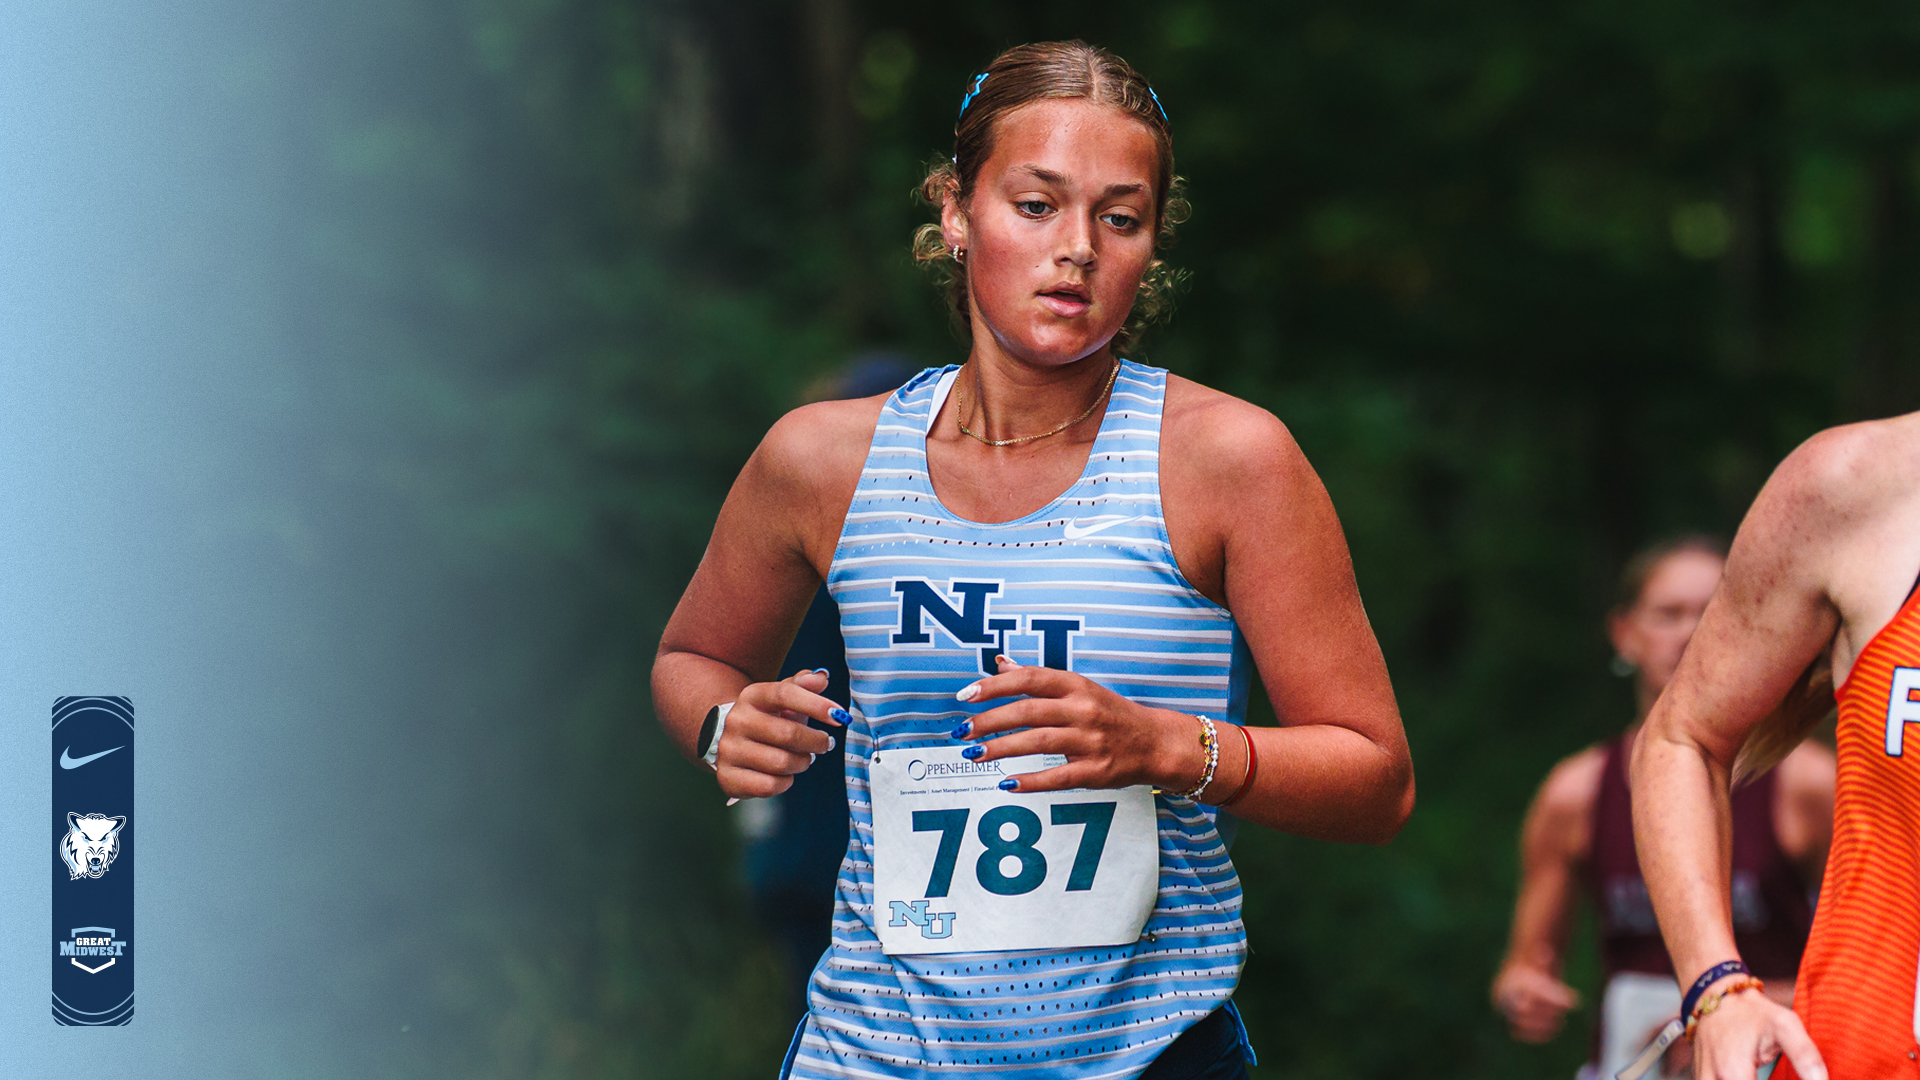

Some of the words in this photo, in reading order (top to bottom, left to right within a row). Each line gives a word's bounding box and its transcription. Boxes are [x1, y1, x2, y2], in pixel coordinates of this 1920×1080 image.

[889, 576, 1085, 677] NU
[908, 759, 1006, 781] OPPENHEIMER
[912, 802, 1117, 898] 787
[889, 900, 956, 939] NU
